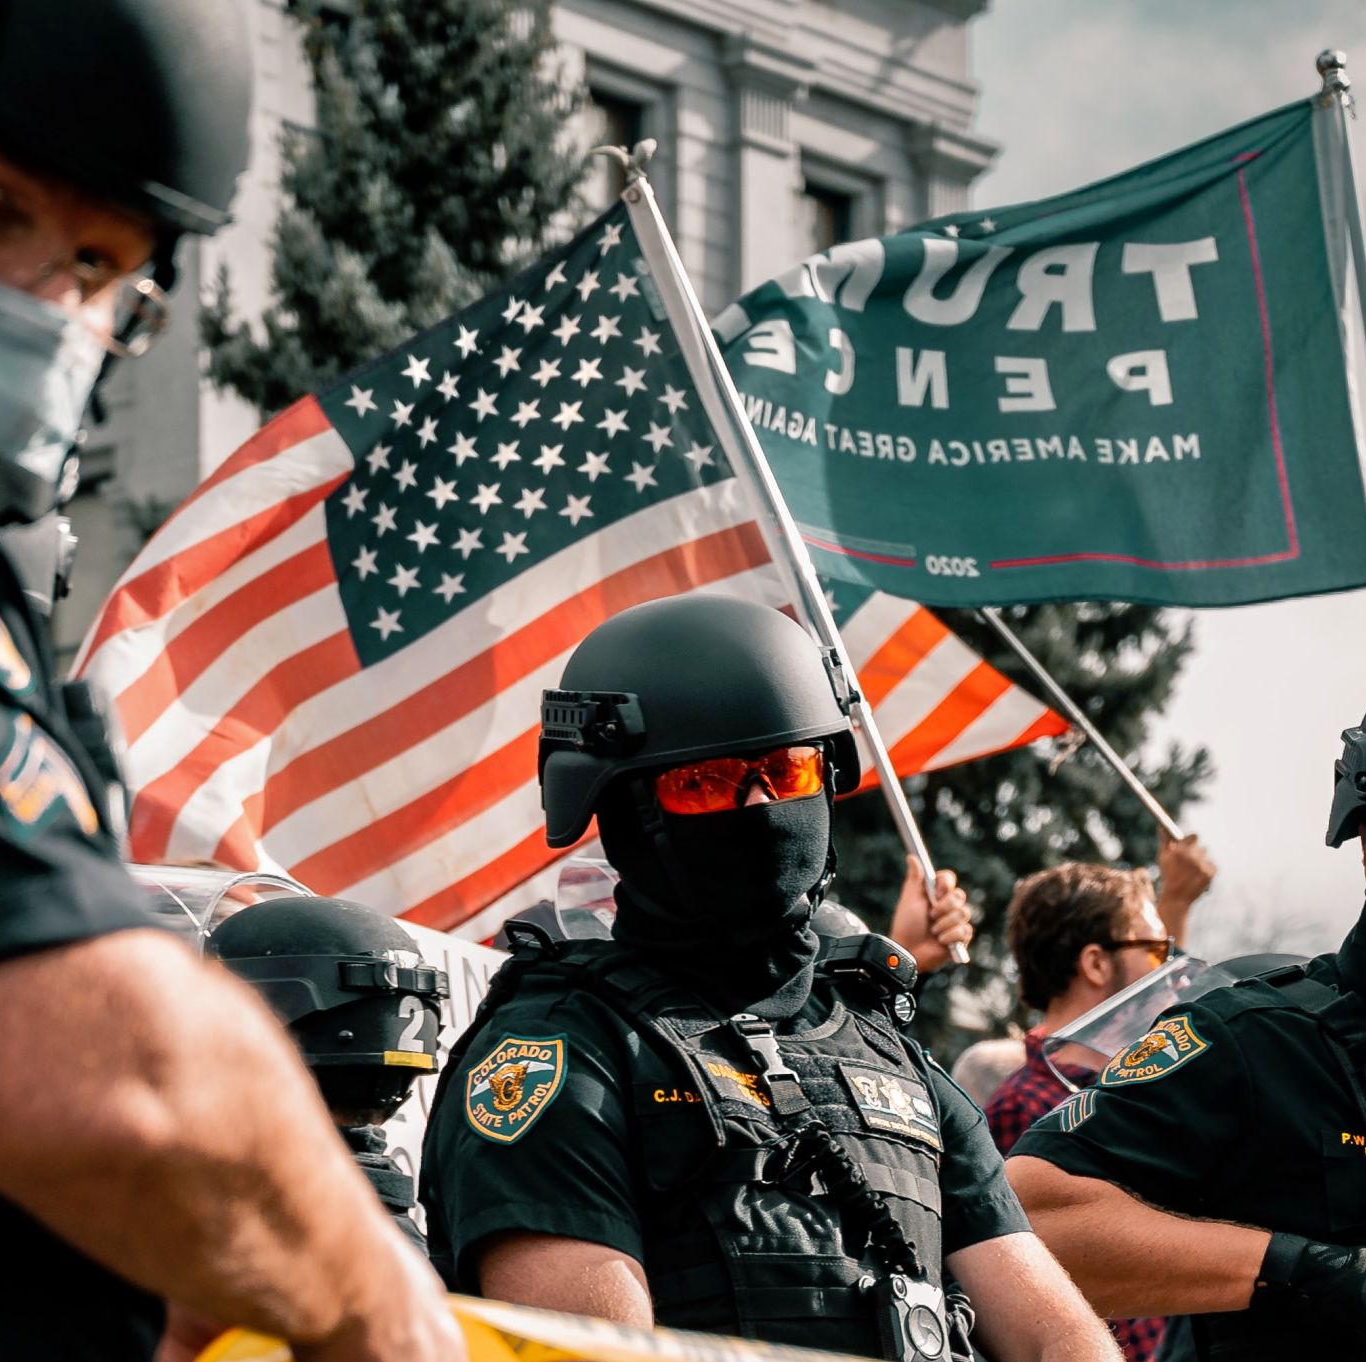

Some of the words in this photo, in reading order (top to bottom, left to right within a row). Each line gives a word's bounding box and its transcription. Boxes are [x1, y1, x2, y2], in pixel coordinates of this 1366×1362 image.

[397, 995, 425, 1053] 2
[473, 1046, 553, 1086] COLORADO
[473, 1103, 504, 1128] STATE
[508, 1081, 553, 1125] PATROL
